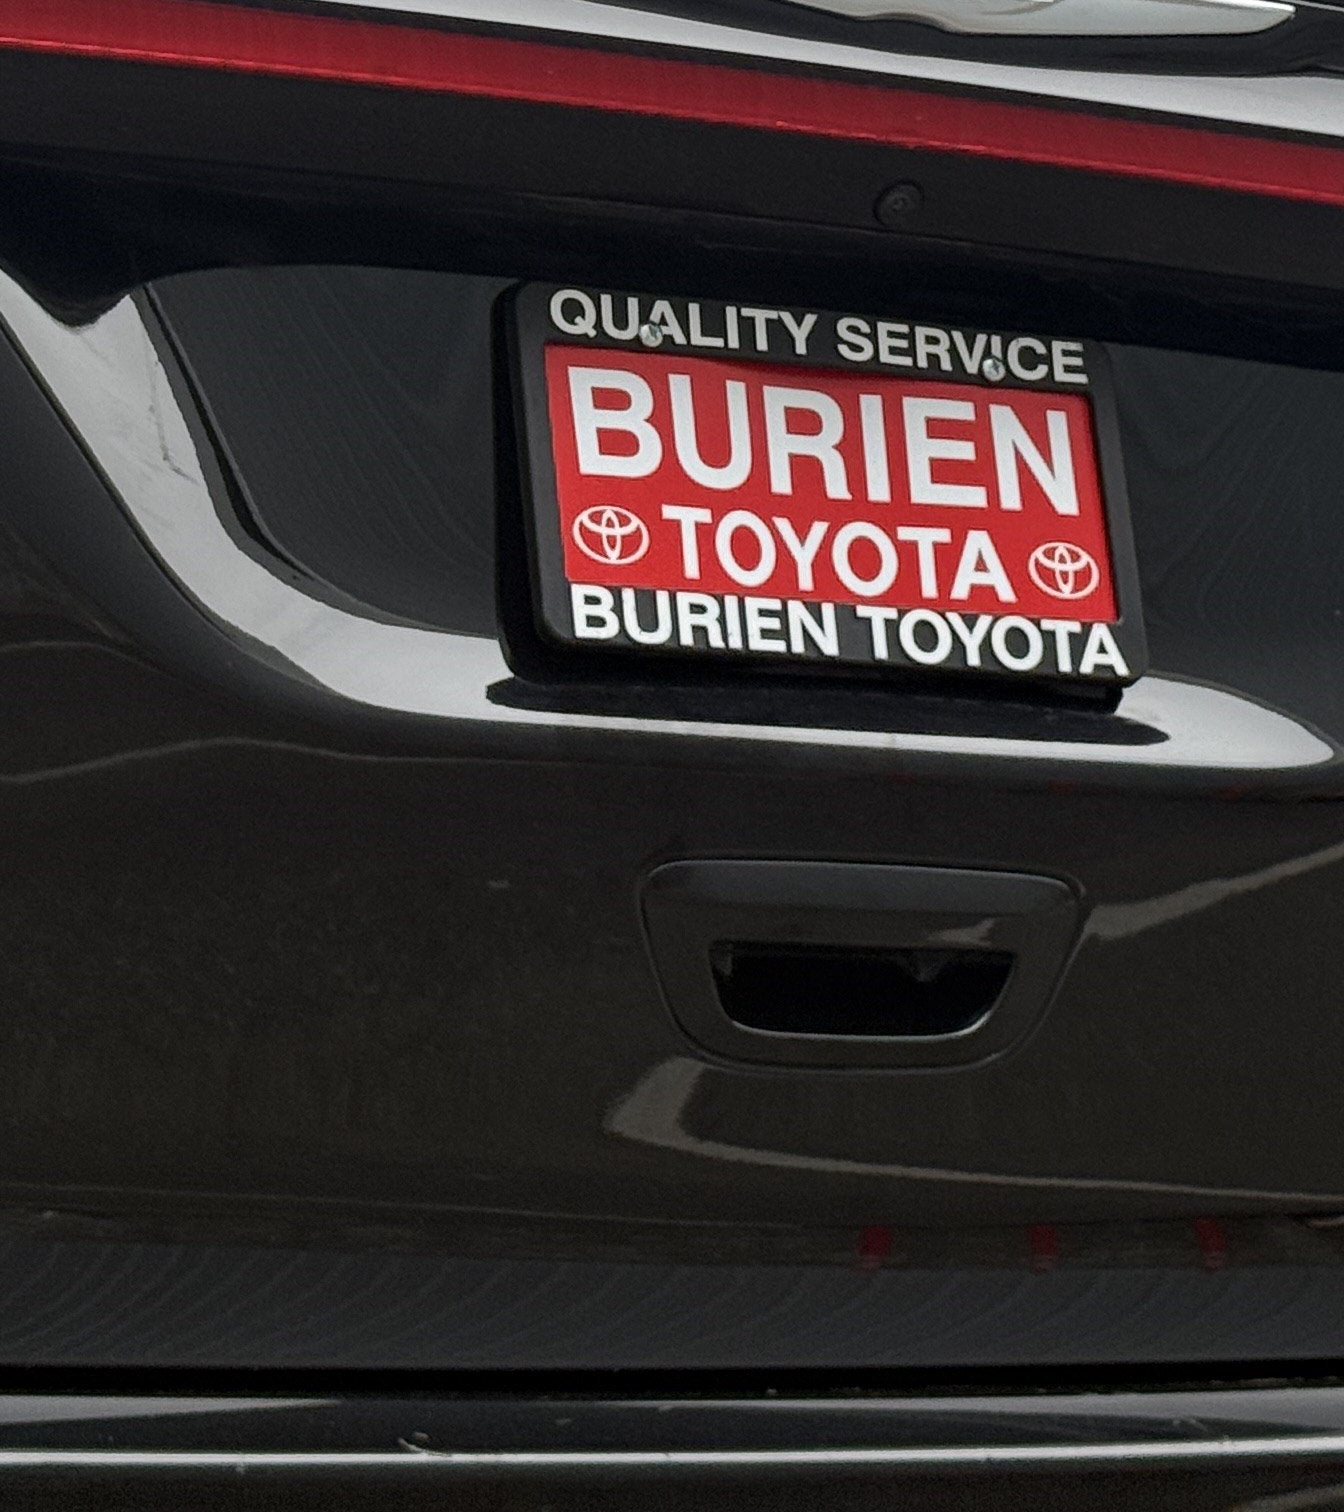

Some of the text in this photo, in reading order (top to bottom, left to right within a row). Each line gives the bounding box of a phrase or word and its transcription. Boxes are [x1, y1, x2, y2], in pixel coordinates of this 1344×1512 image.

[550, 289, 1089, 385] QUALITY SERVICE
[566, 366, 1079, 516] BURIEN
[661, 504, 1017, 603] TOYOTA
[570, 583, 1129, 676] BURIEN TOYOTA
